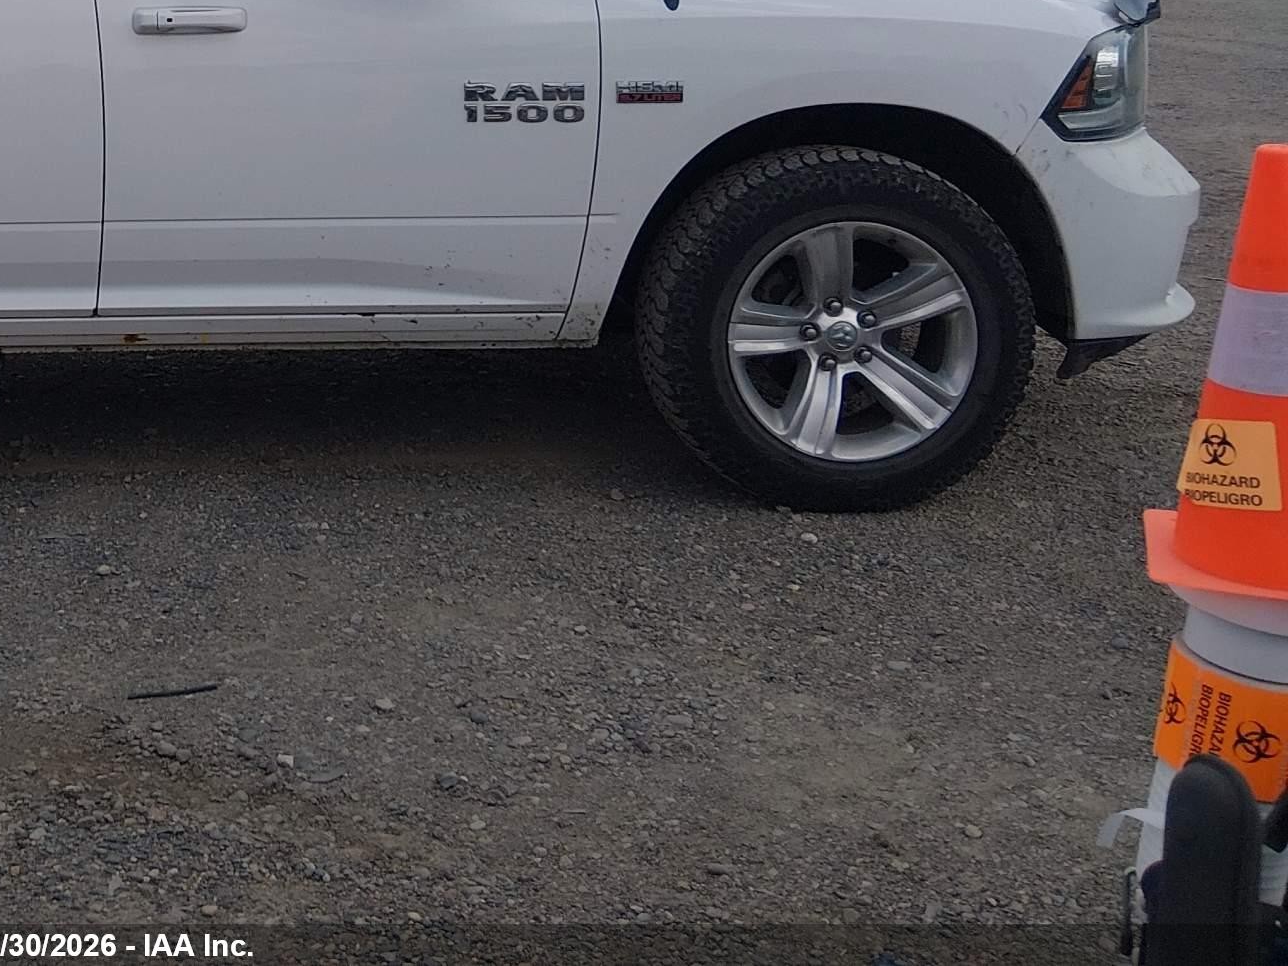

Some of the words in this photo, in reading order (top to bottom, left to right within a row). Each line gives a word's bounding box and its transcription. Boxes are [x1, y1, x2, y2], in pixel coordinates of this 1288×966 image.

[463, 80, 585, 101] RAM
[464, 104, 585, 123] 1500
[1185, 471, 1261, 489] BIOHAZARD
[1184, 488, 1263, 507] BIOPELIGRO
[1189, 684, 1213, 756] BIOPELIGR
[1209, 692, 1232, 757] BIOHAZA
